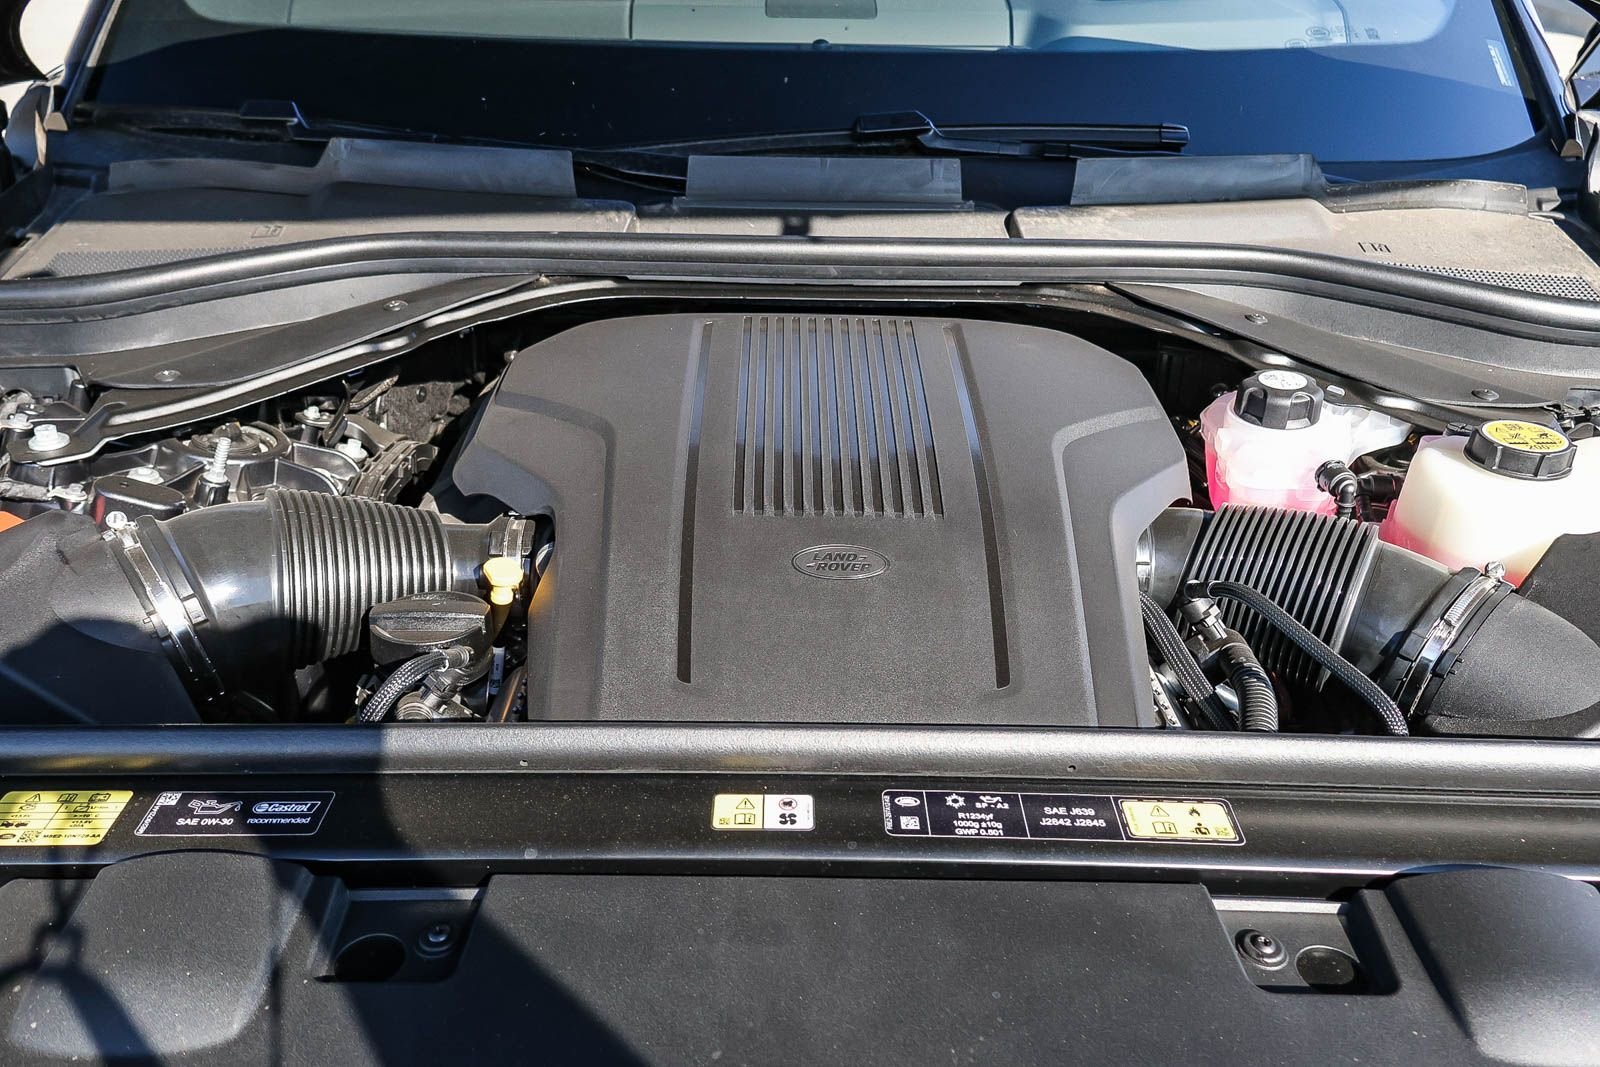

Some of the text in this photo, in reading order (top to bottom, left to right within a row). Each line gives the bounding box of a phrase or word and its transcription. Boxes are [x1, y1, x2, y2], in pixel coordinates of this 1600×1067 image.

[812, 552, 858, 562] LAND
[815, 562, 872, 572] ROVER
[267, 802, 309, 812] Castrol
[1043, 806, 1096, 816] SAE J639
[175, 817, 234, 825] SAE 0W-30
[246, 816, 311, 824] recommended
[957, 812, 994, 821] R1234yf
[953, 820, 980, 829] 1000g
[1039, 817, 1107, 827] J2842 J2845
